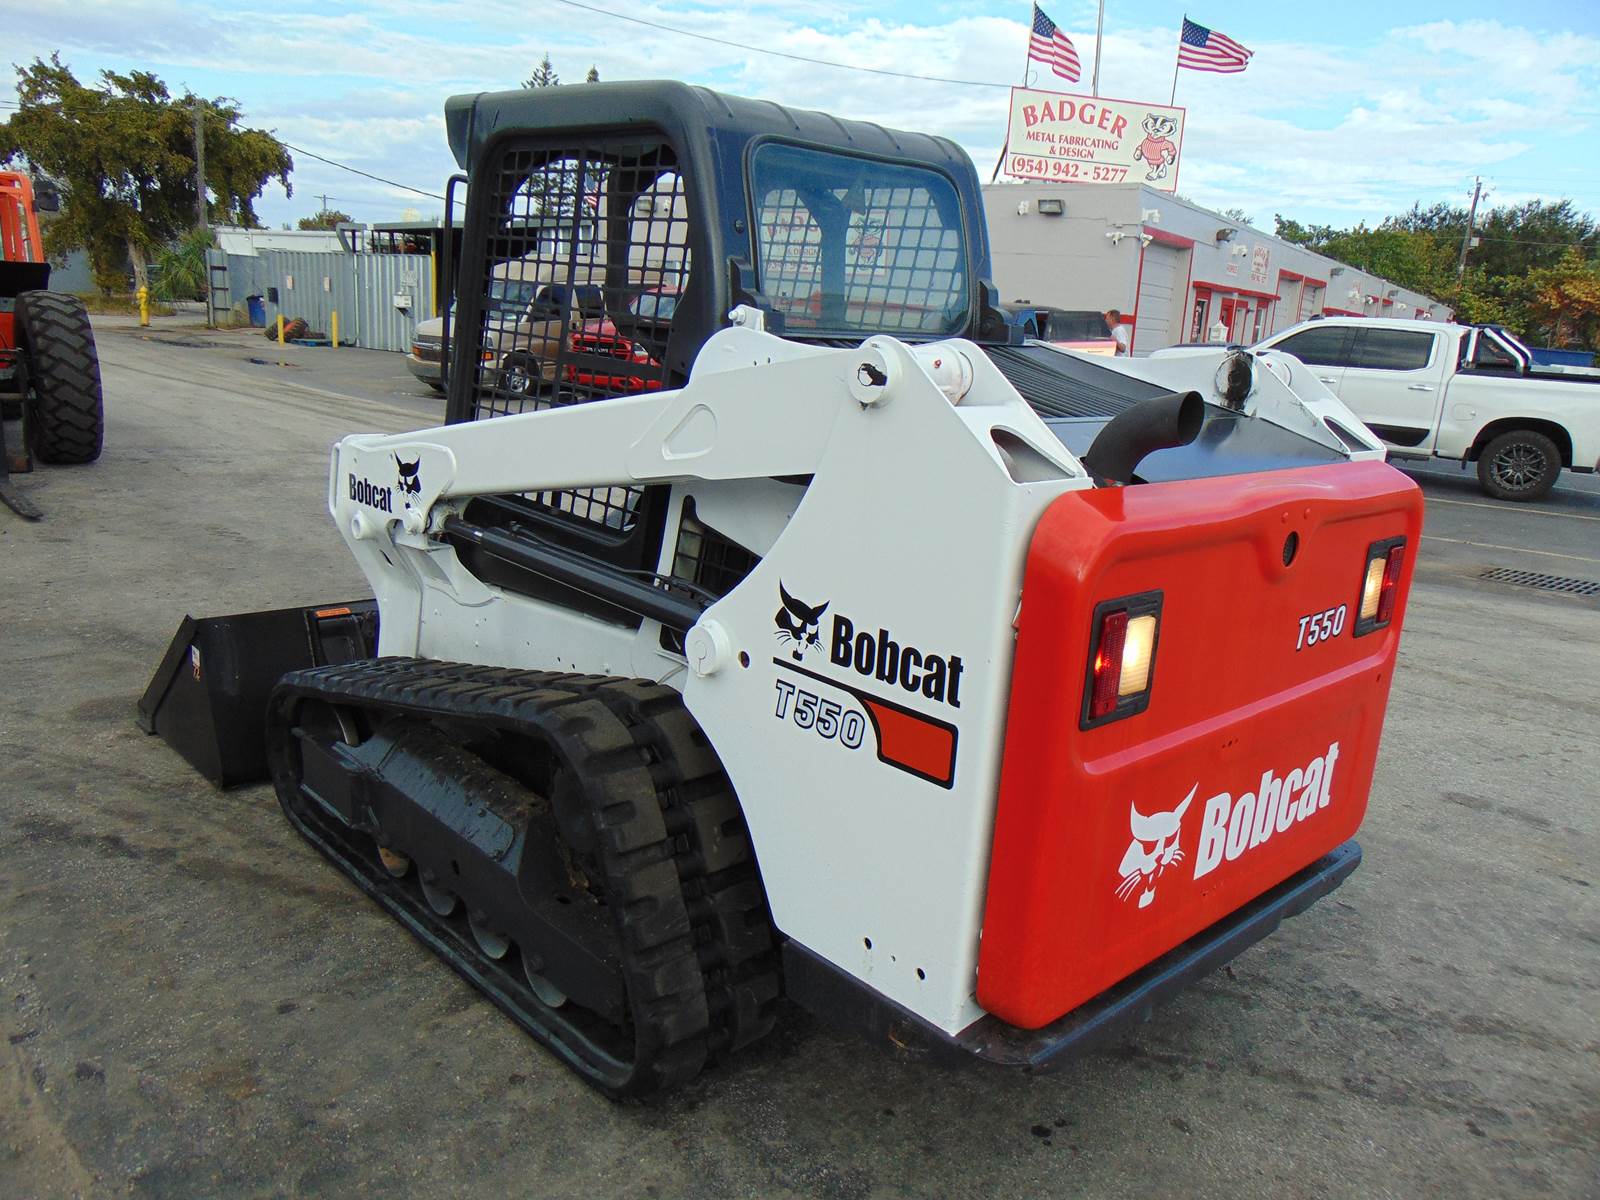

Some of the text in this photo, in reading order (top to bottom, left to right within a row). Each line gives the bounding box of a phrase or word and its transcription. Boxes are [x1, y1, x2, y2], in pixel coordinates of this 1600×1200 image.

[1022, 100, 1128, 139] BADGER
[1026, 130, 1119, 151] METAL FABRICATING
[1049, 145, 1095, 159] & DESIGN
[1011, 155, 1049, 176] (954)
[1052, 161, 1079, 178] 942
[1092, 166, 1128, 182] 5277
[349, 473, 393, 513] Bobcat
[1296, 603, 1347, 652] T550
[830, 613, 964, 709] Bobcat
[775, 678, 866, 750] T550
[1193, 741, 1340, 881] Bobcat
